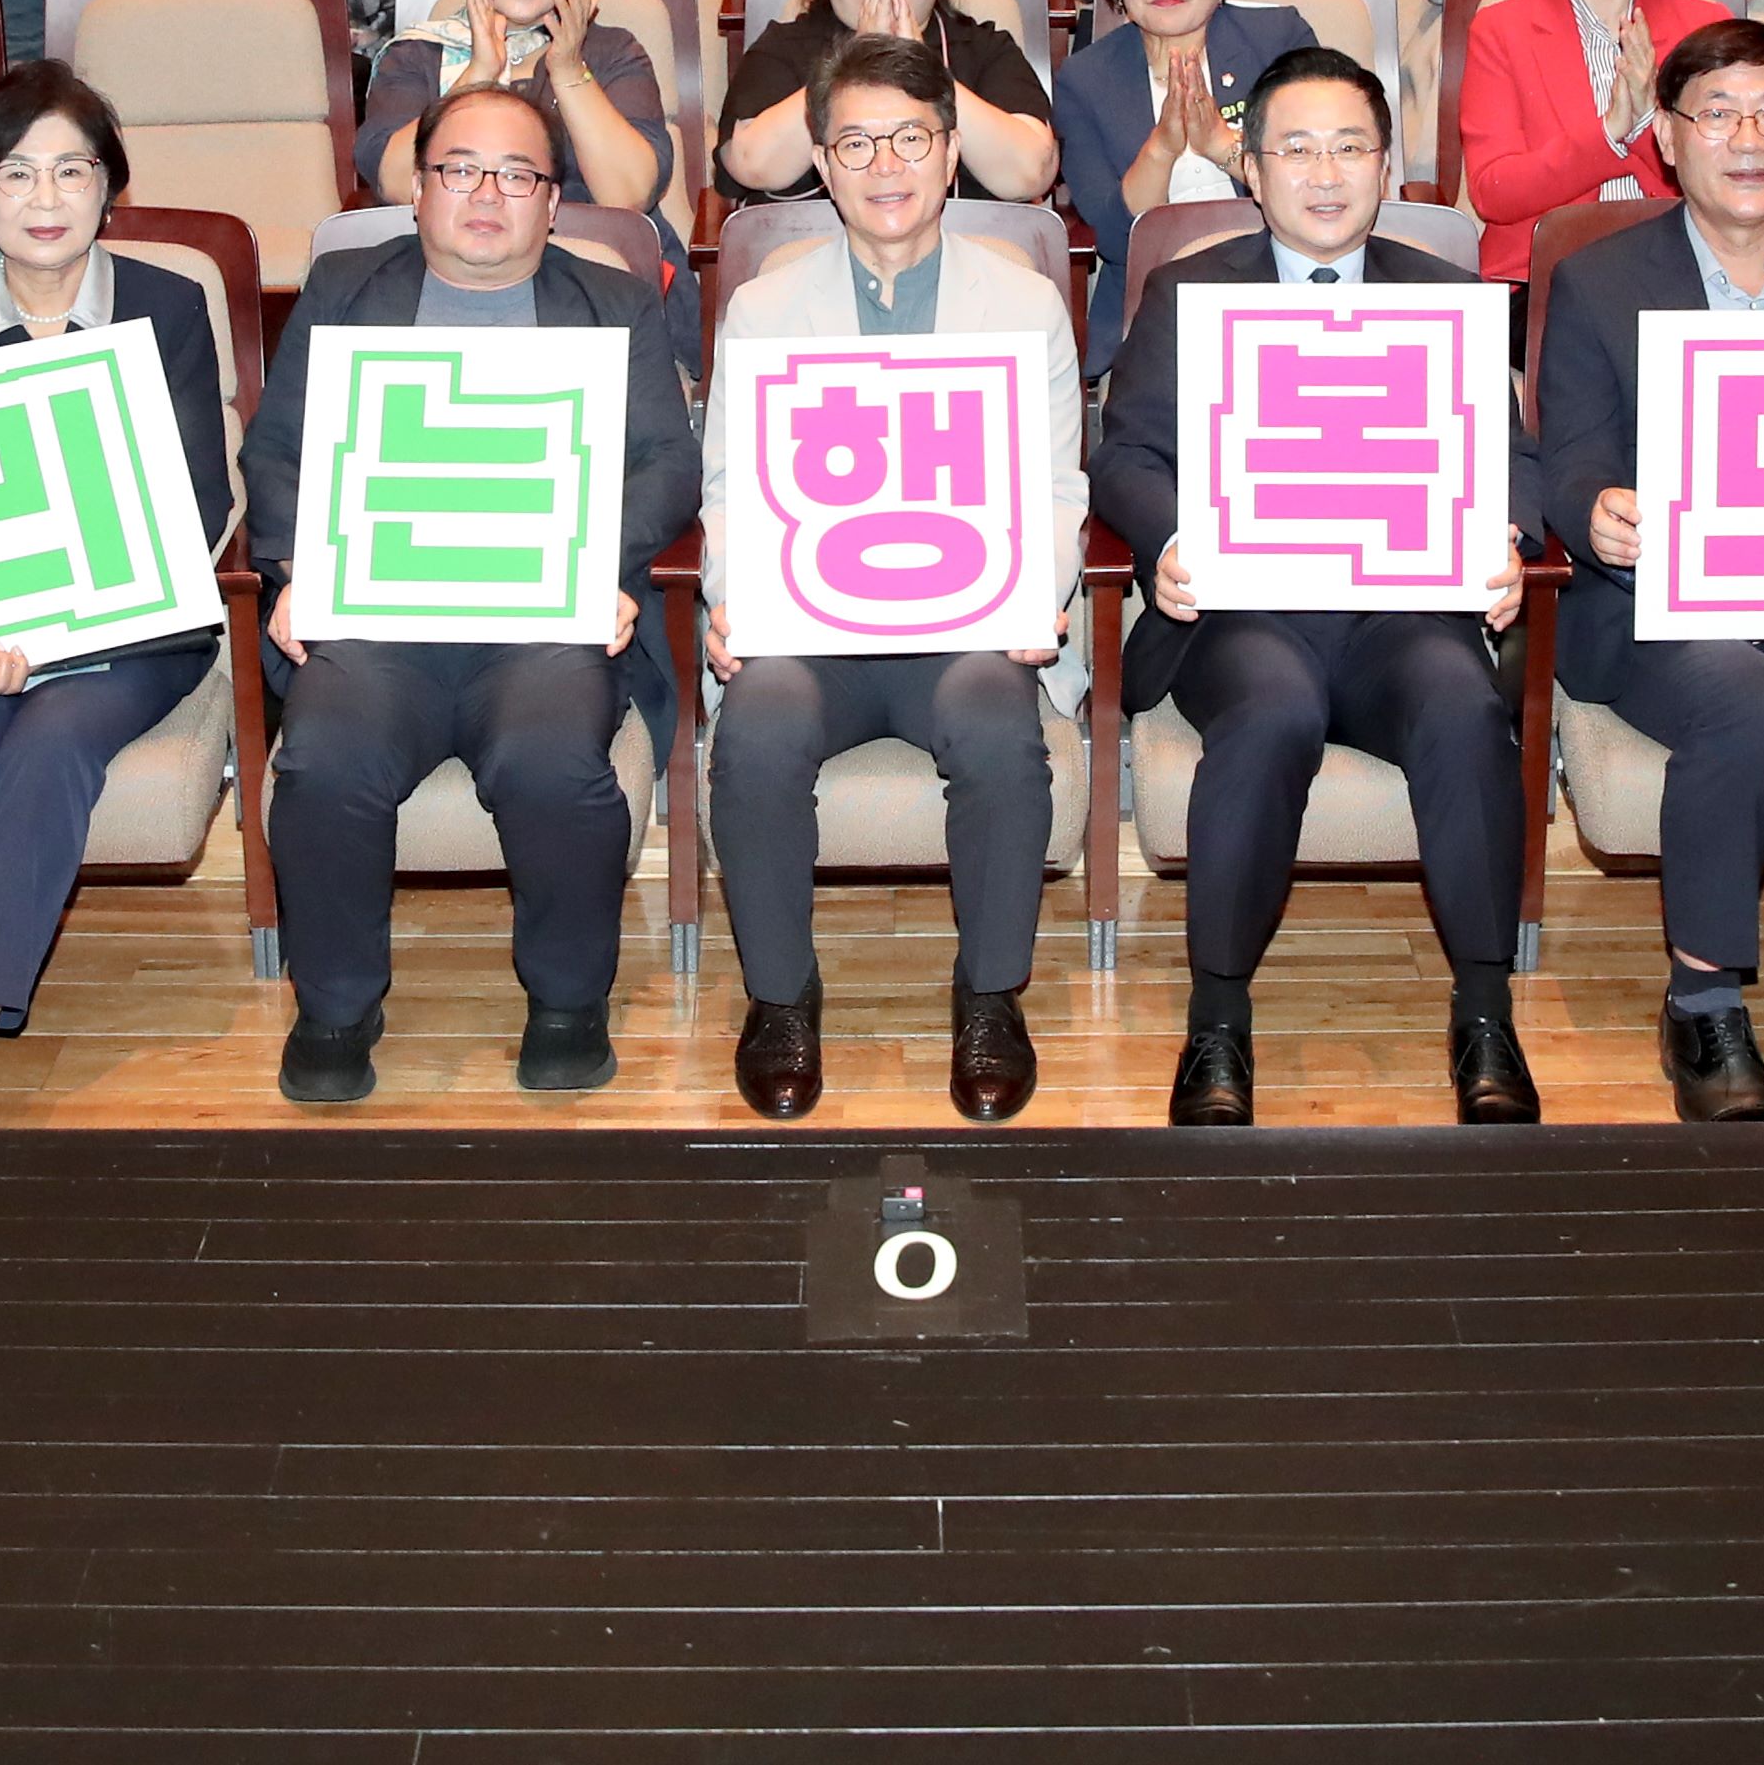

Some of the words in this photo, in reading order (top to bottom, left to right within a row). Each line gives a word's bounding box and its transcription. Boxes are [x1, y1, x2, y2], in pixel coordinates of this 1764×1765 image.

[328, 351, 591, 618] 는
[755, 352, 1022, 636] 행
[1210, 309, 1475, 586] 복
